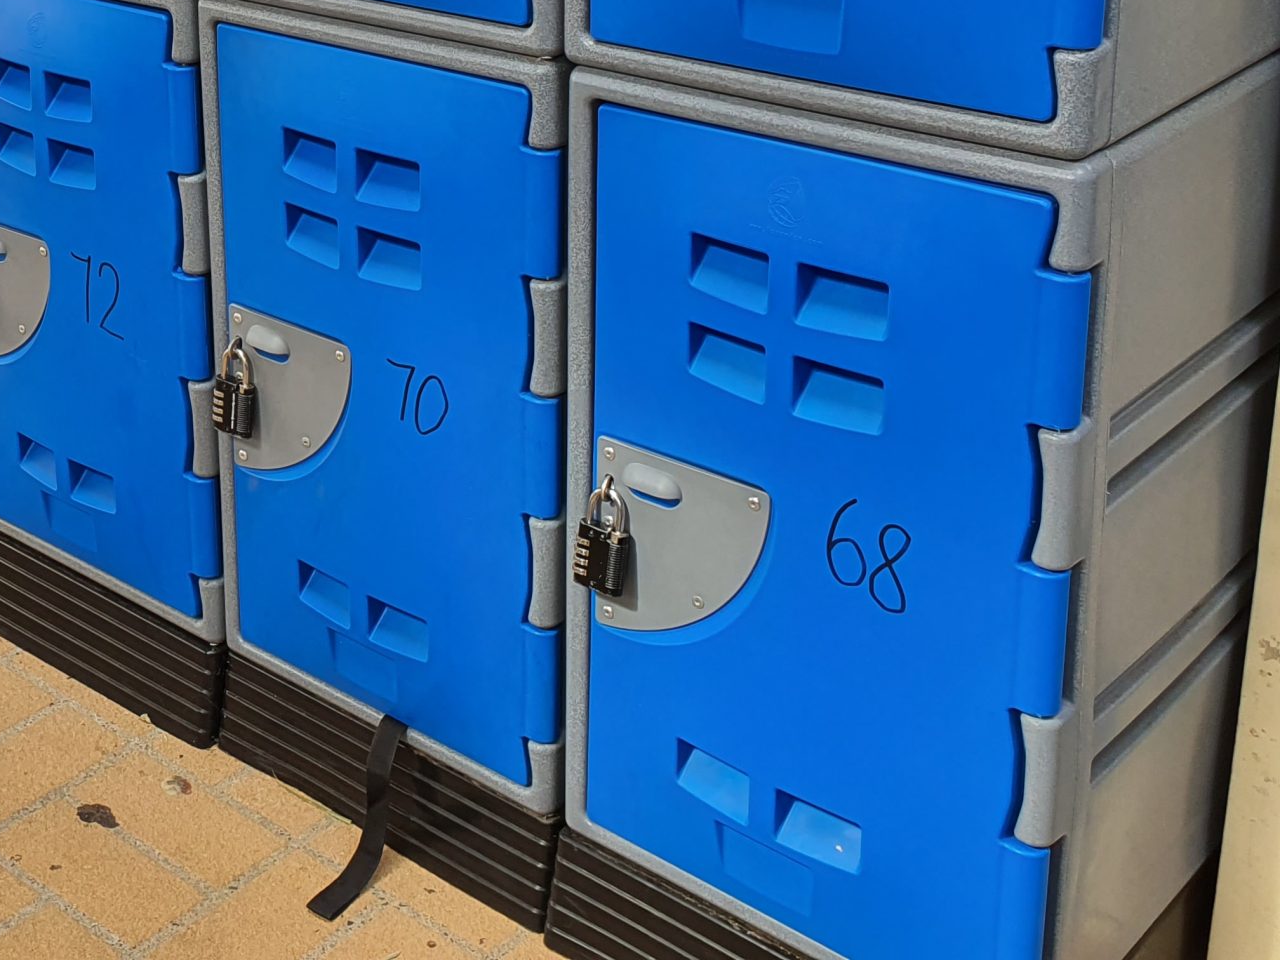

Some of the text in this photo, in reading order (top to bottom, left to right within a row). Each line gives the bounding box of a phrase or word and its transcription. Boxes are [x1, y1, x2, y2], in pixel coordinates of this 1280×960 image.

[70, 250, 125, 342] 72
[386, 358, 449, 436] 70
[826, 498, 912, 614] 68
